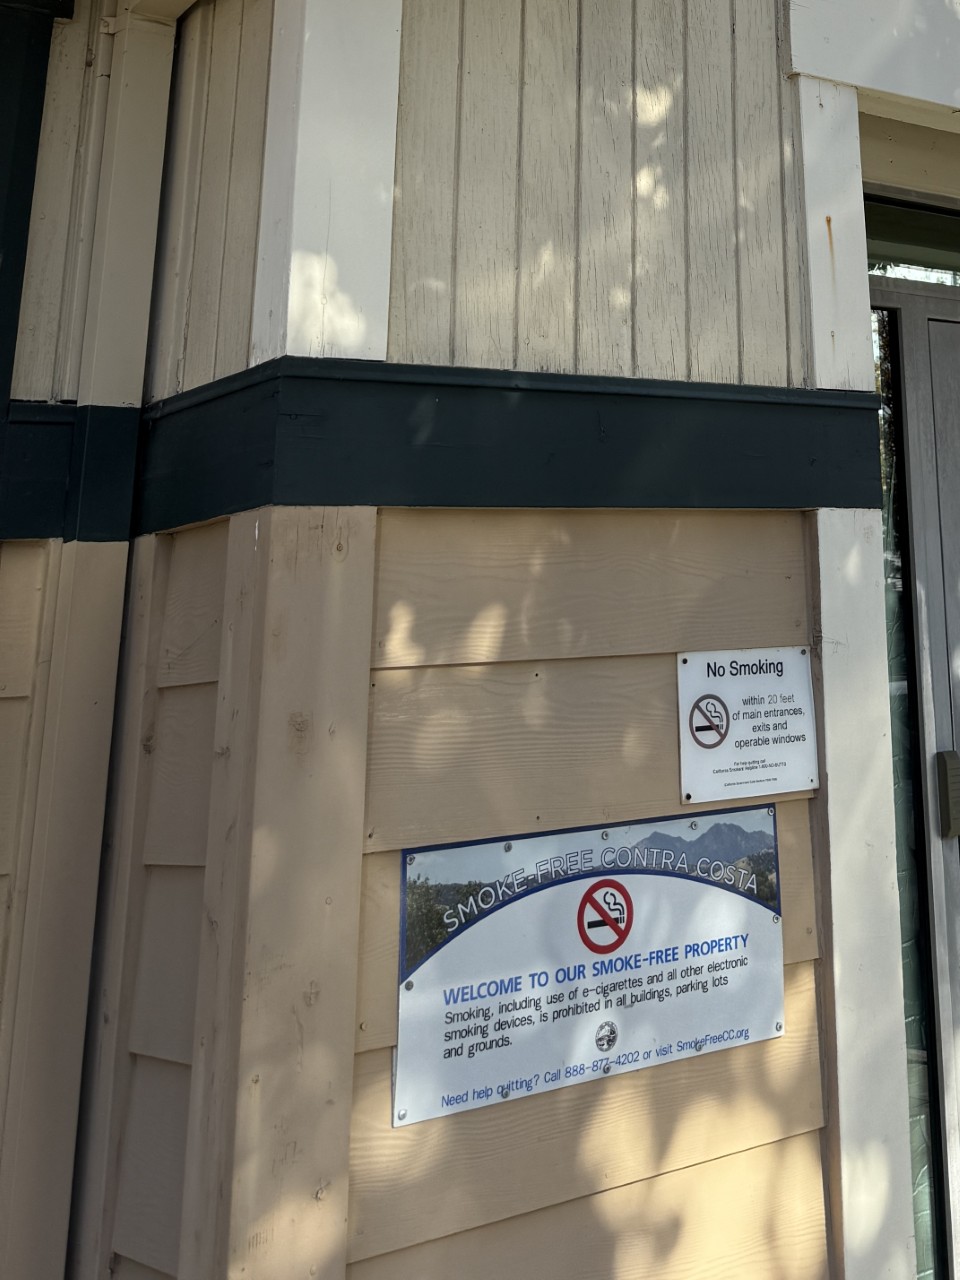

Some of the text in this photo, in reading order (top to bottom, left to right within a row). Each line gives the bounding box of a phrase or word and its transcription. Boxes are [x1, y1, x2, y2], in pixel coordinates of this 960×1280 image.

[706, 659, 784, 678] No Smoking
[742, 693, 795, 706] within 20 feet
[732, 707, 805, 720] of main entrances,
[752, 720, 788, 732] exits and
[734, 733, 806, 749] operable windows
[443, 846, 758, 932] SMOKE-FREE CONTRA COSTA
[443, 933, 749, 1006] WELCOME TO OUR SMOKE-FREE PROPERTY
[445, 955, 748, 1024] Smoking, including use of e-cigarettes and all other electronic
[444, 975, 728, 1042] smoking devices, is prohibited in all buildings, parking lots
[443, 1034, 512, 1059] and grounds.
[441, 1028, 750, 1108] Need help quitting? Call 888-877-4202 or visit SmokeFreeCC.org
